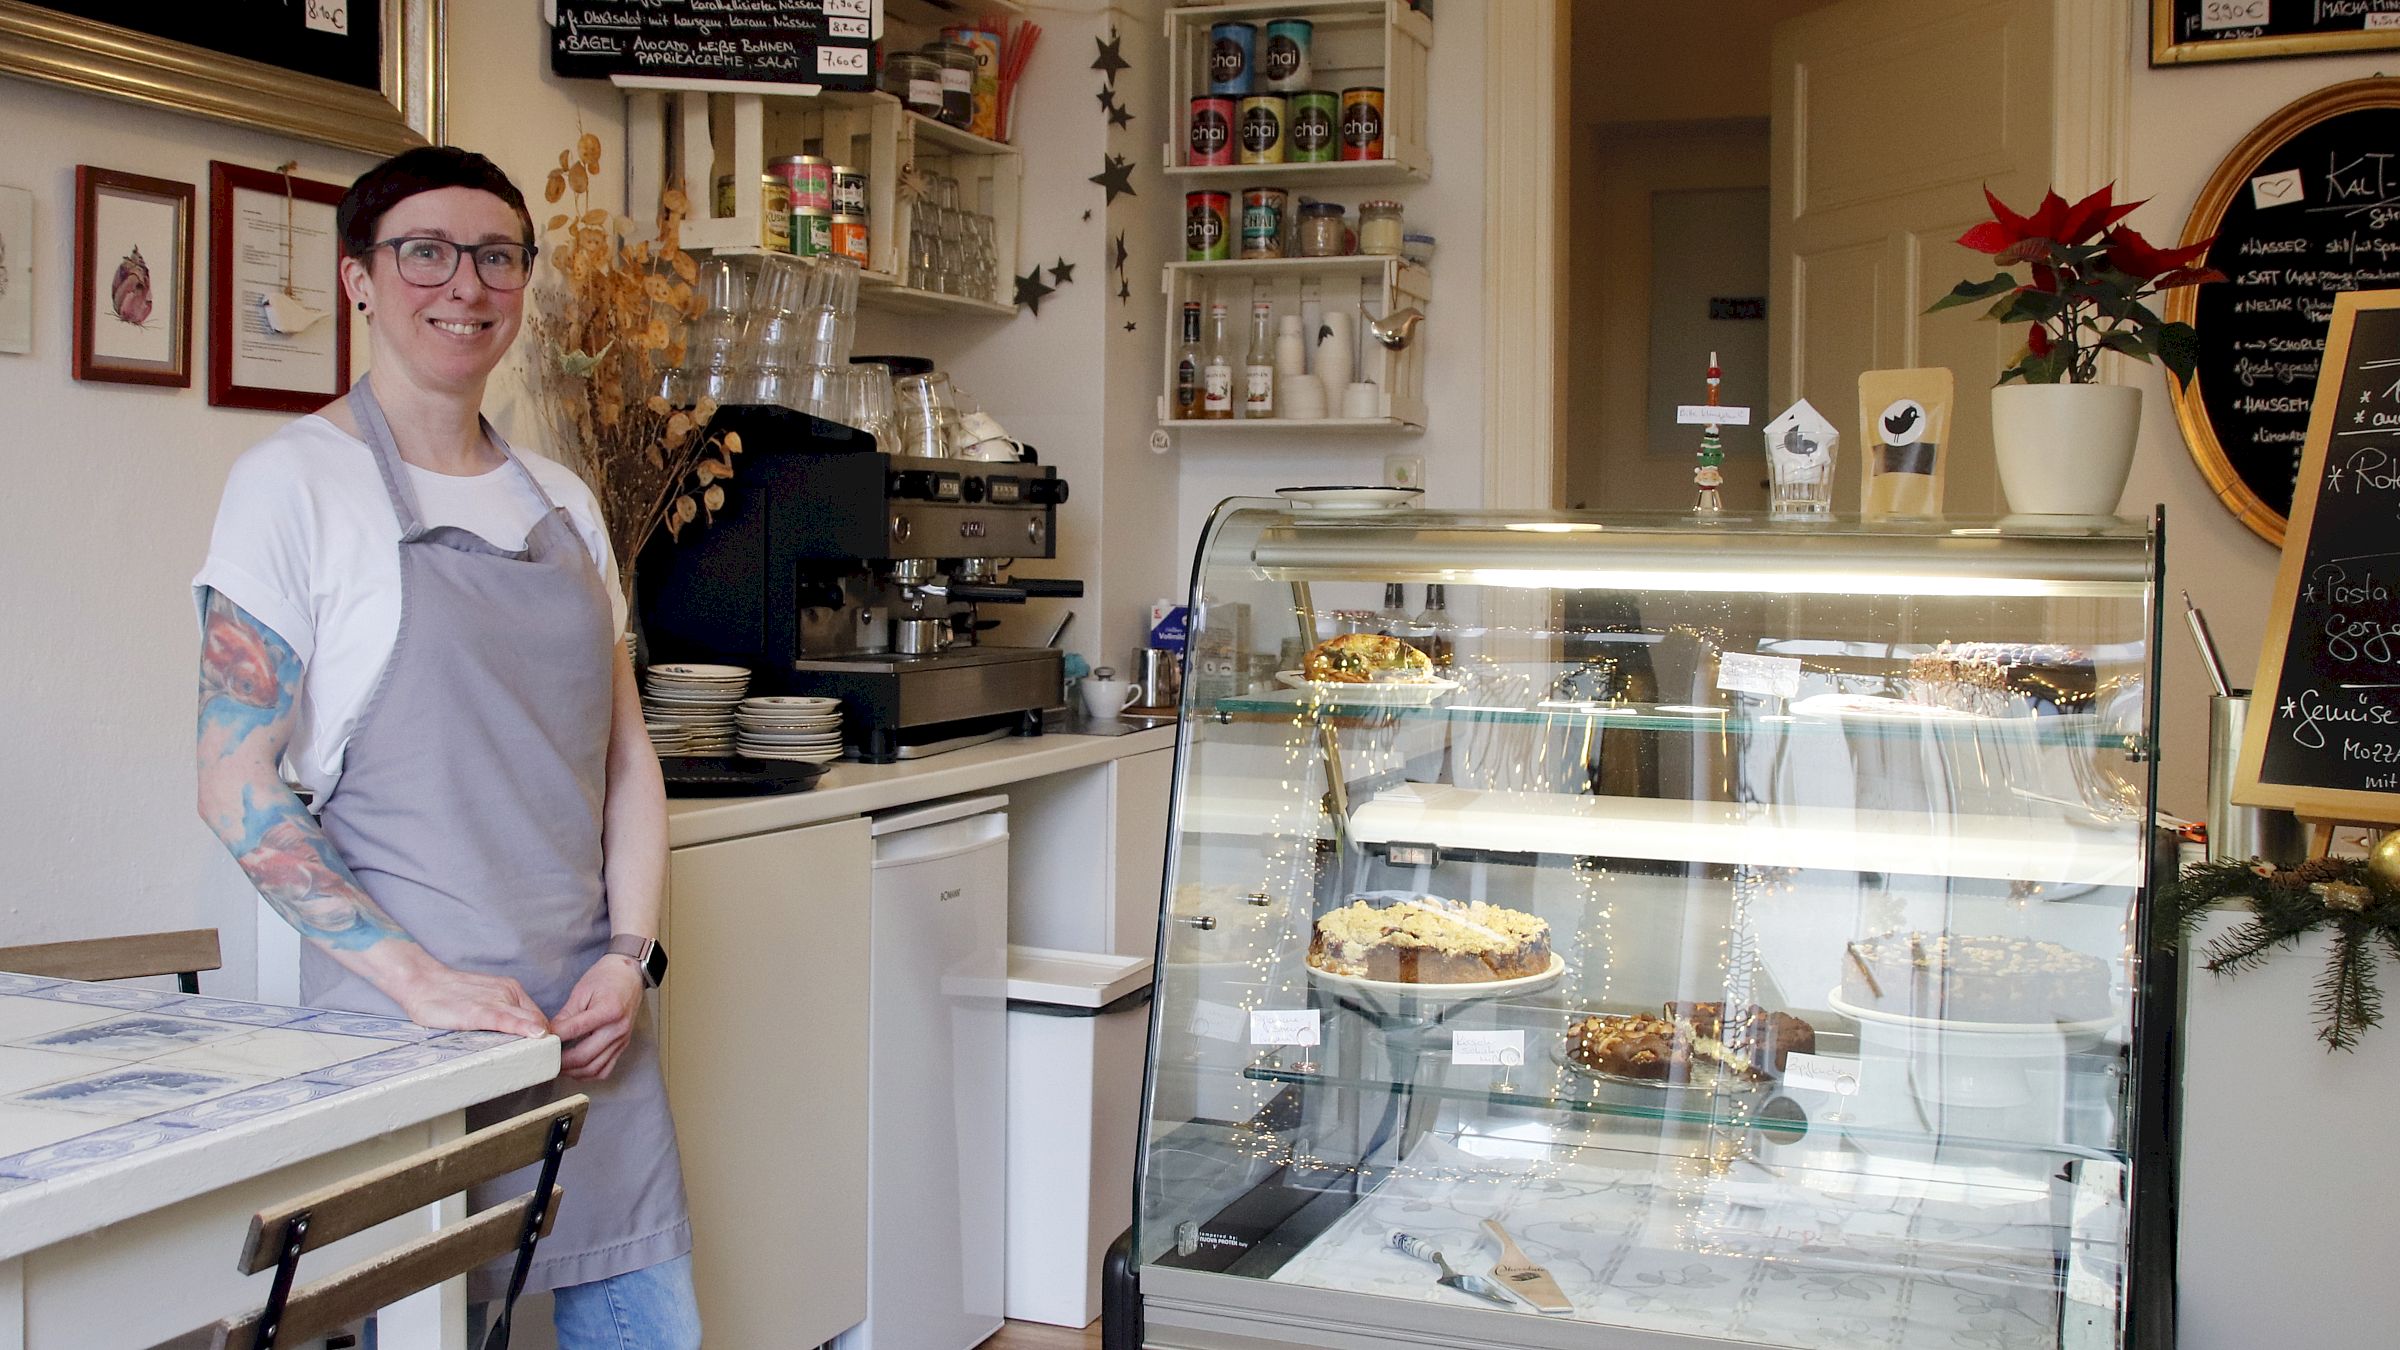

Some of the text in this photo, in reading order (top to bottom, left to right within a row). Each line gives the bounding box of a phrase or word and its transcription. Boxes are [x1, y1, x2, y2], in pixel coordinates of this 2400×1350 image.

[1191, 125, 1225, 140] chai
[1243, 122, 1275, 138] chai
[1294, 121, 1329, 137] chai
[1344, 119, 1378, 135] chai
[1187, 221, 1219, 237] chai
[2312, 563, 2388, 605] Pasta
[2293, 689, 2399, 749] Gemüse
[2365, 773, 2398, 789] mit
